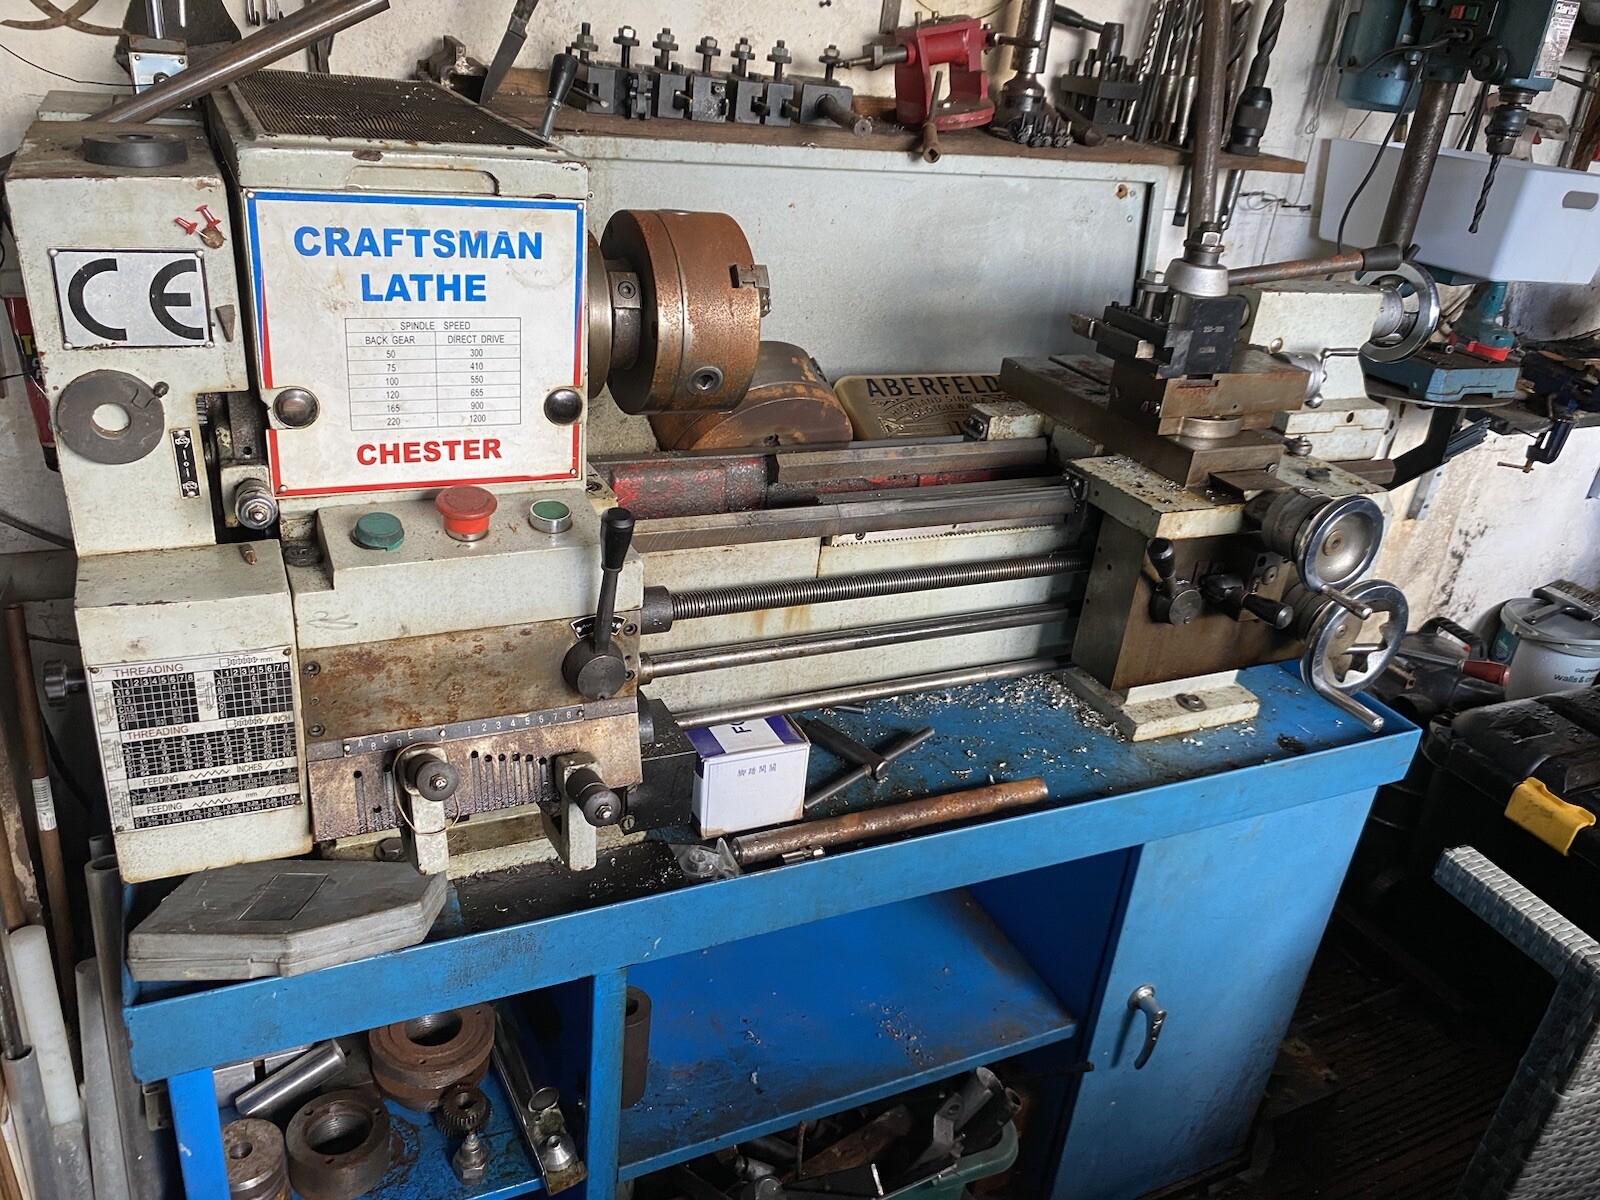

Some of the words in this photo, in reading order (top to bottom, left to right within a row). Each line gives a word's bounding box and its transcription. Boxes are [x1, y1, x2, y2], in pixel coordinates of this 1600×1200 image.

[294, 226, 542, 260] CRAFTSMAN
[361, 274, 486, 301] LATHE
[400, 322, 434, 330] SPINDLE
[444, 321, 470, 330] SPEED
[365, 336, 388, 345] BACK
[448, 335, 477, 343] DIRECT
[386, 350, 395, 358] 50
[387, 364, 396, 372] 75
[356, 438, 502, 465] CHESTER
[114, 664, 184, 677] THREADING
[128, 726, 188, 739] THREADING
[143, 775, 178, 786] FEEDING
[237, 763, 262, 772] INCHES
[147, 803, 182, 813] FEEDING
